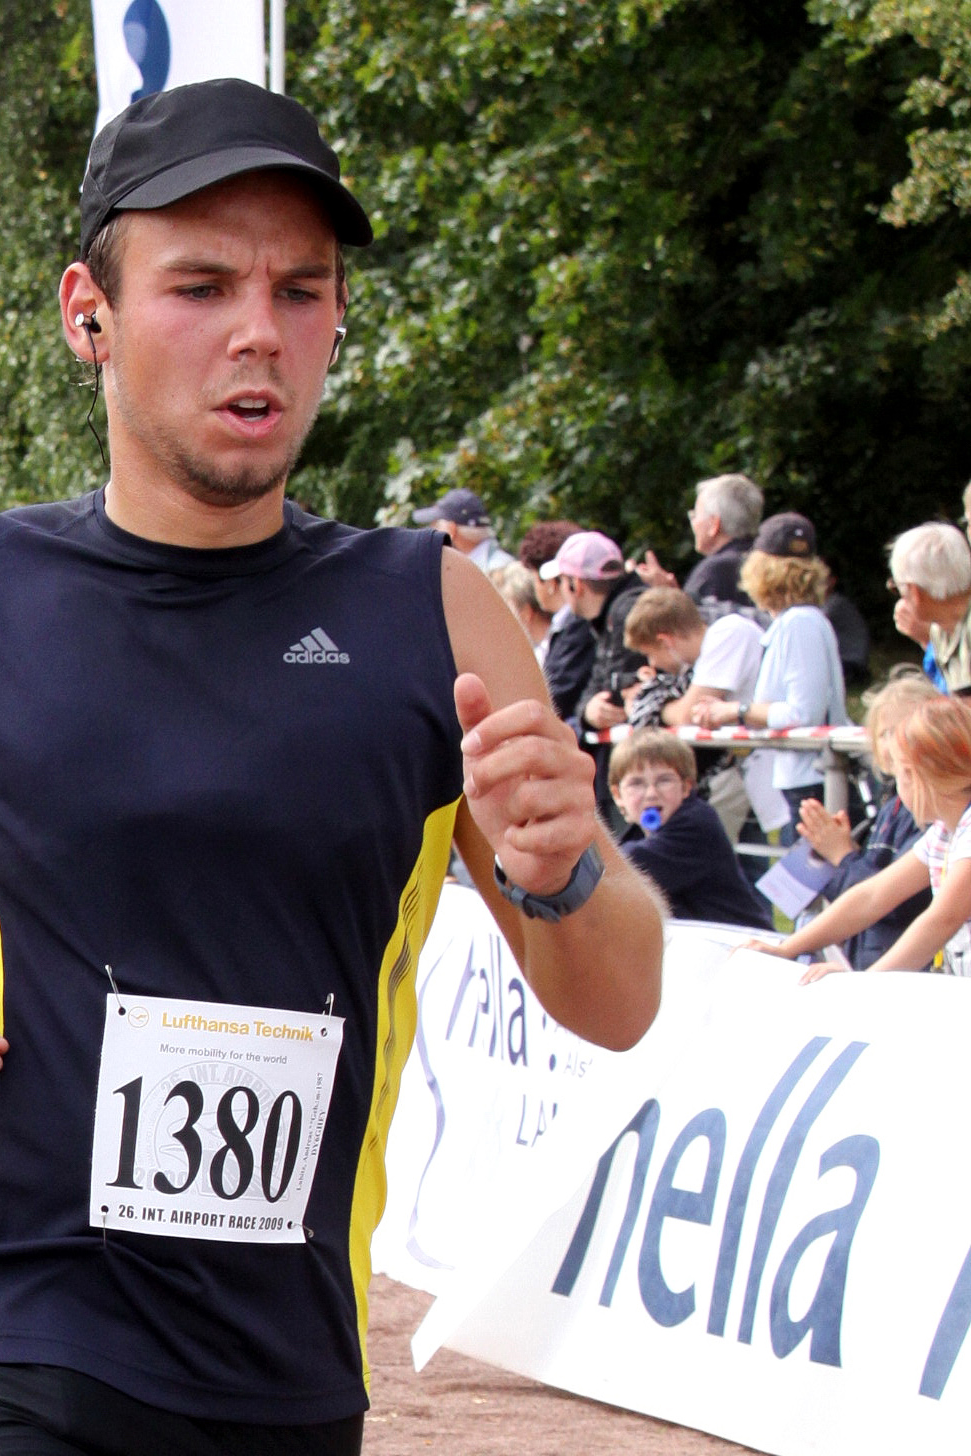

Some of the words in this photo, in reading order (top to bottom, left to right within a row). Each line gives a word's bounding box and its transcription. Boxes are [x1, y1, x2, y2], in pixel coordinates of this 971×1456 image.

[282, 650, 350, 665] adidas
[161, 1011, 250, 1035] Lufthansa
[253, 1020, 314, 1042] Technik
[159, 1043, 185, 1055] More
[187, 1047, 227, 1059] mobility
[229, 1049, 243, 1060] for
[246, 1052, 260, 1062] the
[262, 1055, 287, 1065] world
[105, 1075, 303, 1204] 1380
[550, 1035, 882, 1369] nella
[118, 1204, 138, 1220] 26.
[142, 1207, 167, 1222] INT.
[170, 1210, 225, 1228] AIRPORT
[229, 1215, 257, 1230] RACE
[258, 1217, 284, 1231] 2009
